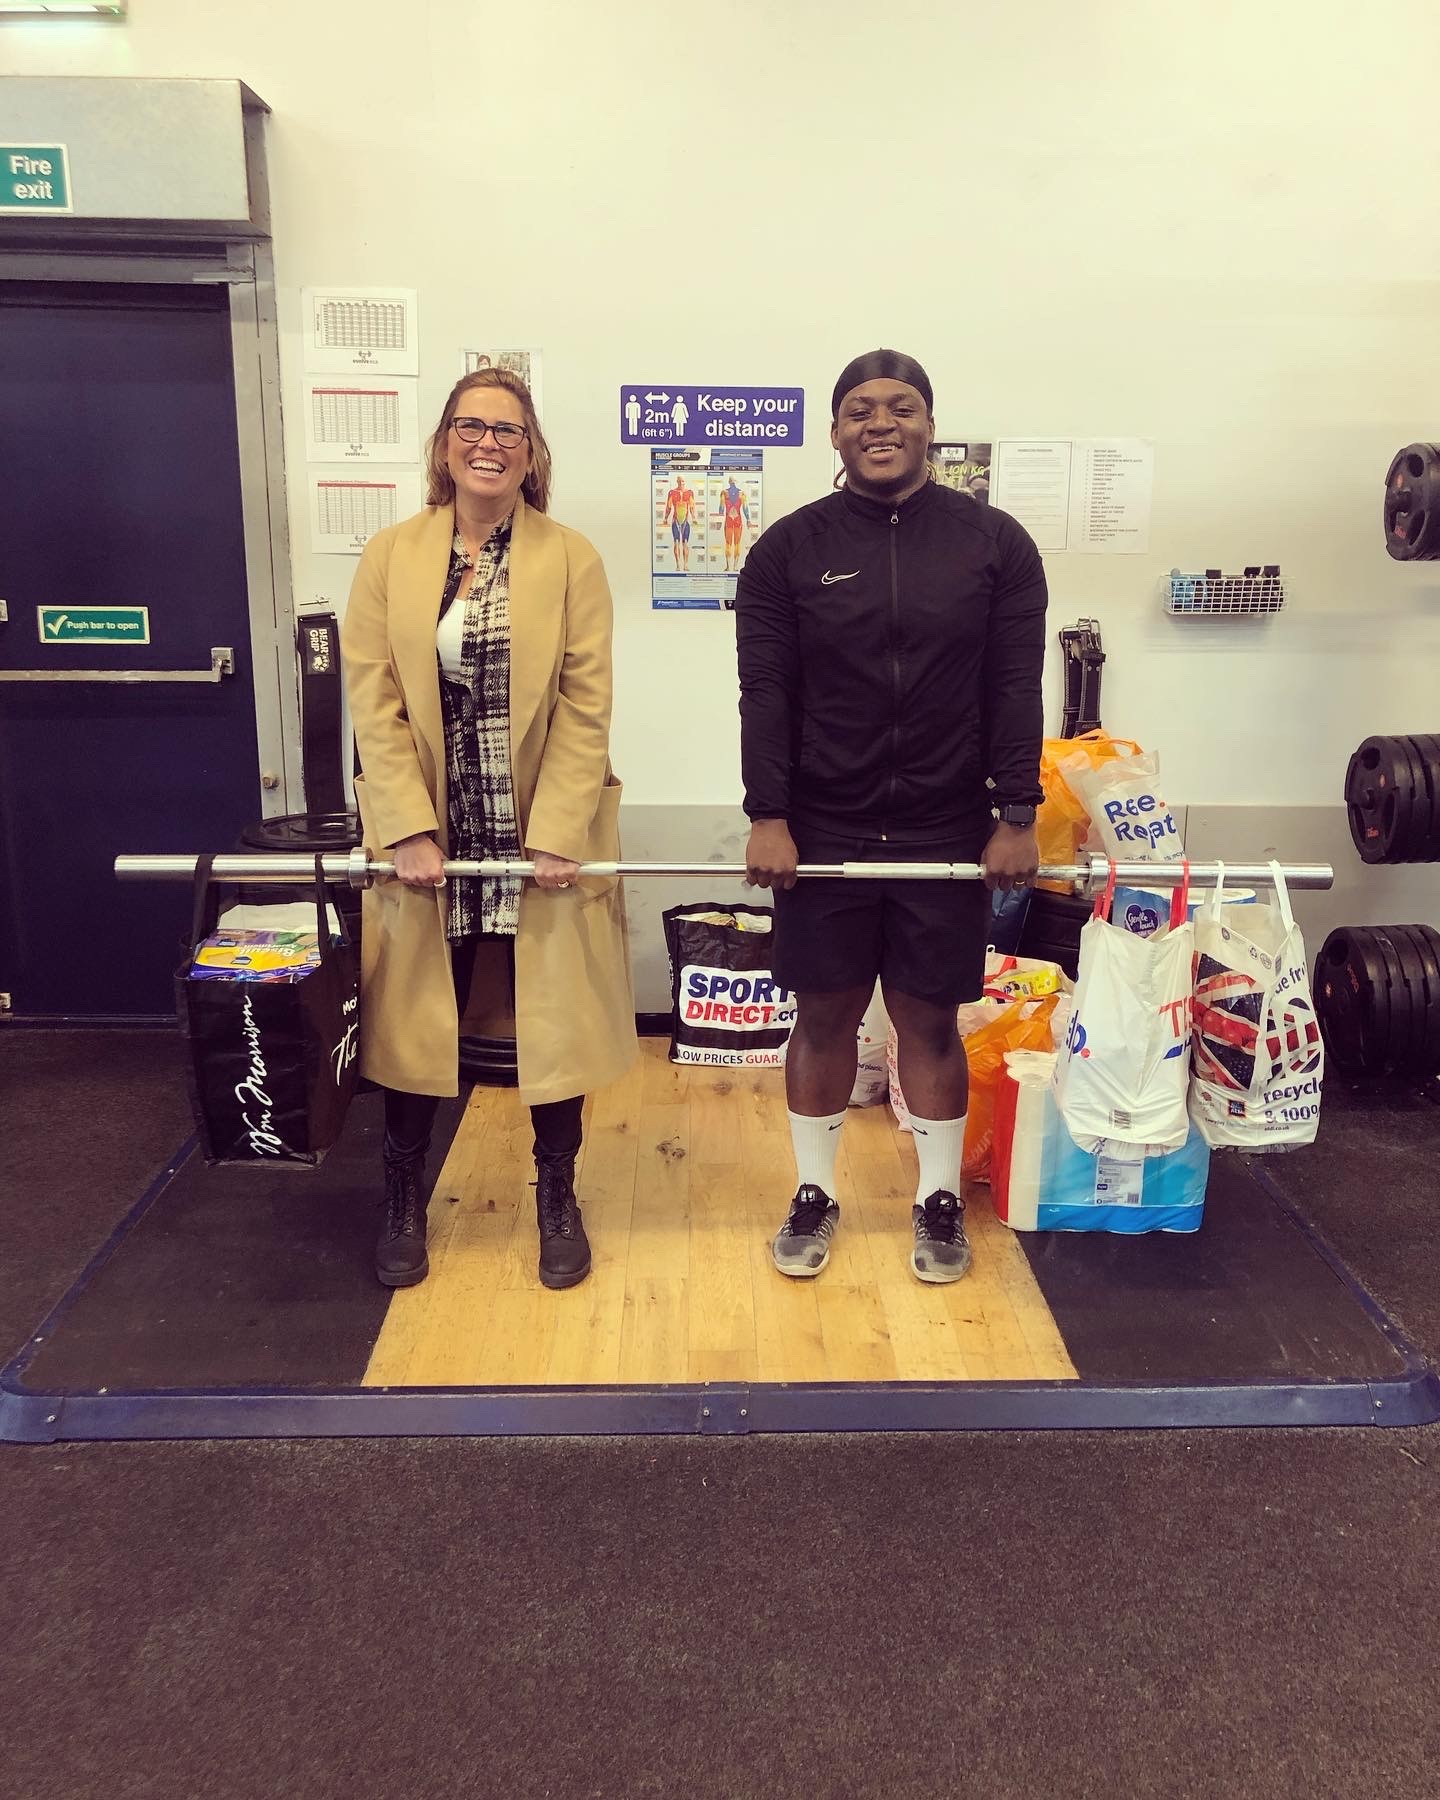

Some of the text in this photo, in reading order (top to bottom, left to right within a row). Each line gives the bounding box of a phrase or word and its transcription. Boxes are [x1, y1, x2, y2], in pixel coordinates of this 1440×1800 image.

[9, 154, 53, 176] Fire
[13, 179, 54, 200] exit
[697, 394, 798, 417] Keep your
[644, 409, 670, 424] 2m
[641, 428, 657, 439] (6ft
[705, 420, 789, 438] distance
[67, 621, 139, 632] Push bar to open
[310, 629, 320, 652] GRIP
[319, 628, 329, 654] BEAR
[688, 972, 797, 1004] SPORT
[679, 1050, 782, 1064] LOW PRICES GUAR
